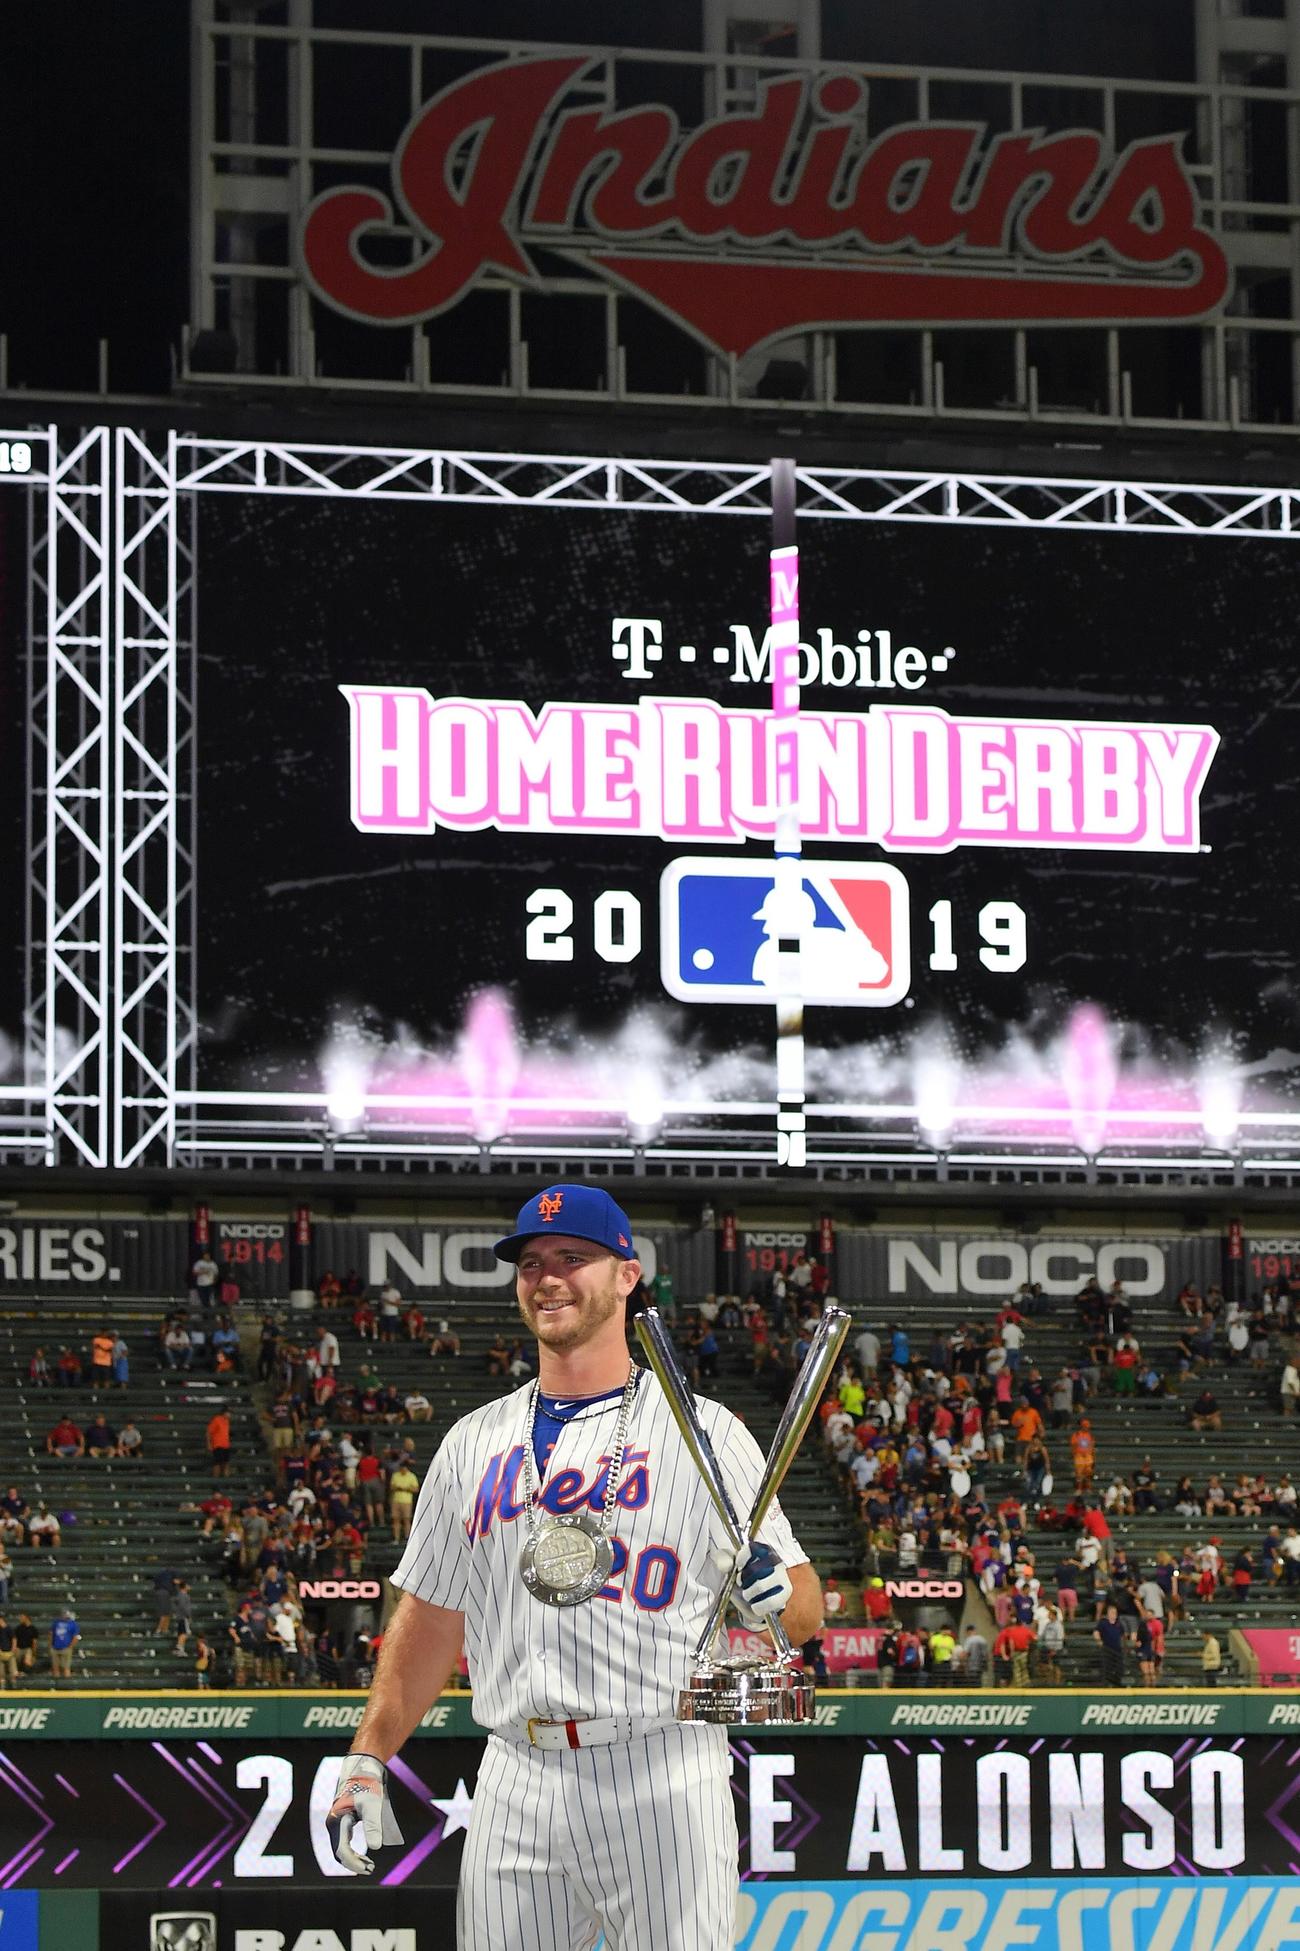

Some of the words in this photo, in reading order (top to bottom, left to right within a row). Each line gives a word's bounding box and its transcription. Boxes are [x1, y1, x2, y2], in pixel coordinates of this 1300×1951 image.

[303, 52, 1235, 327] Indians
[338, 685, 645, 834] HOME
[640, 696, 872, 843] RUN
[868, 705, 1221, 853] DERBY
[526, 889, 642, 964] 20
[929, 900, 1027, 973] 19
[220, 1224, 284, 1239] NOCO
[745, 1232, 807, 1247] NOCO
[221, 1240, 283, 1264] 1914
[1249, 1240, 1300, 1254] NOC
[888, 1240, 1165, 1296] NOCO
[1251, 1254, 1294, 1279] 191
[466, 1443, 650, 1549] Mets
[299, 1581, 380, 1599] NOCO
[885, 1581, 963, 1598] NOCO
[831, 1636, 877, 1657] FAN
[103, 1706, 253, 1729] PROGRESSIVE
[891, 1704, 1033, 1726] PROGRESSIVE
[1081, 1703, 1221, 1725] PROGRESSIVE
[1268, 1703, 1300, 1725] PR
[846, 1750, 1246, 1872] ALONSO
[235, 1928, 416, 1951] RAM
